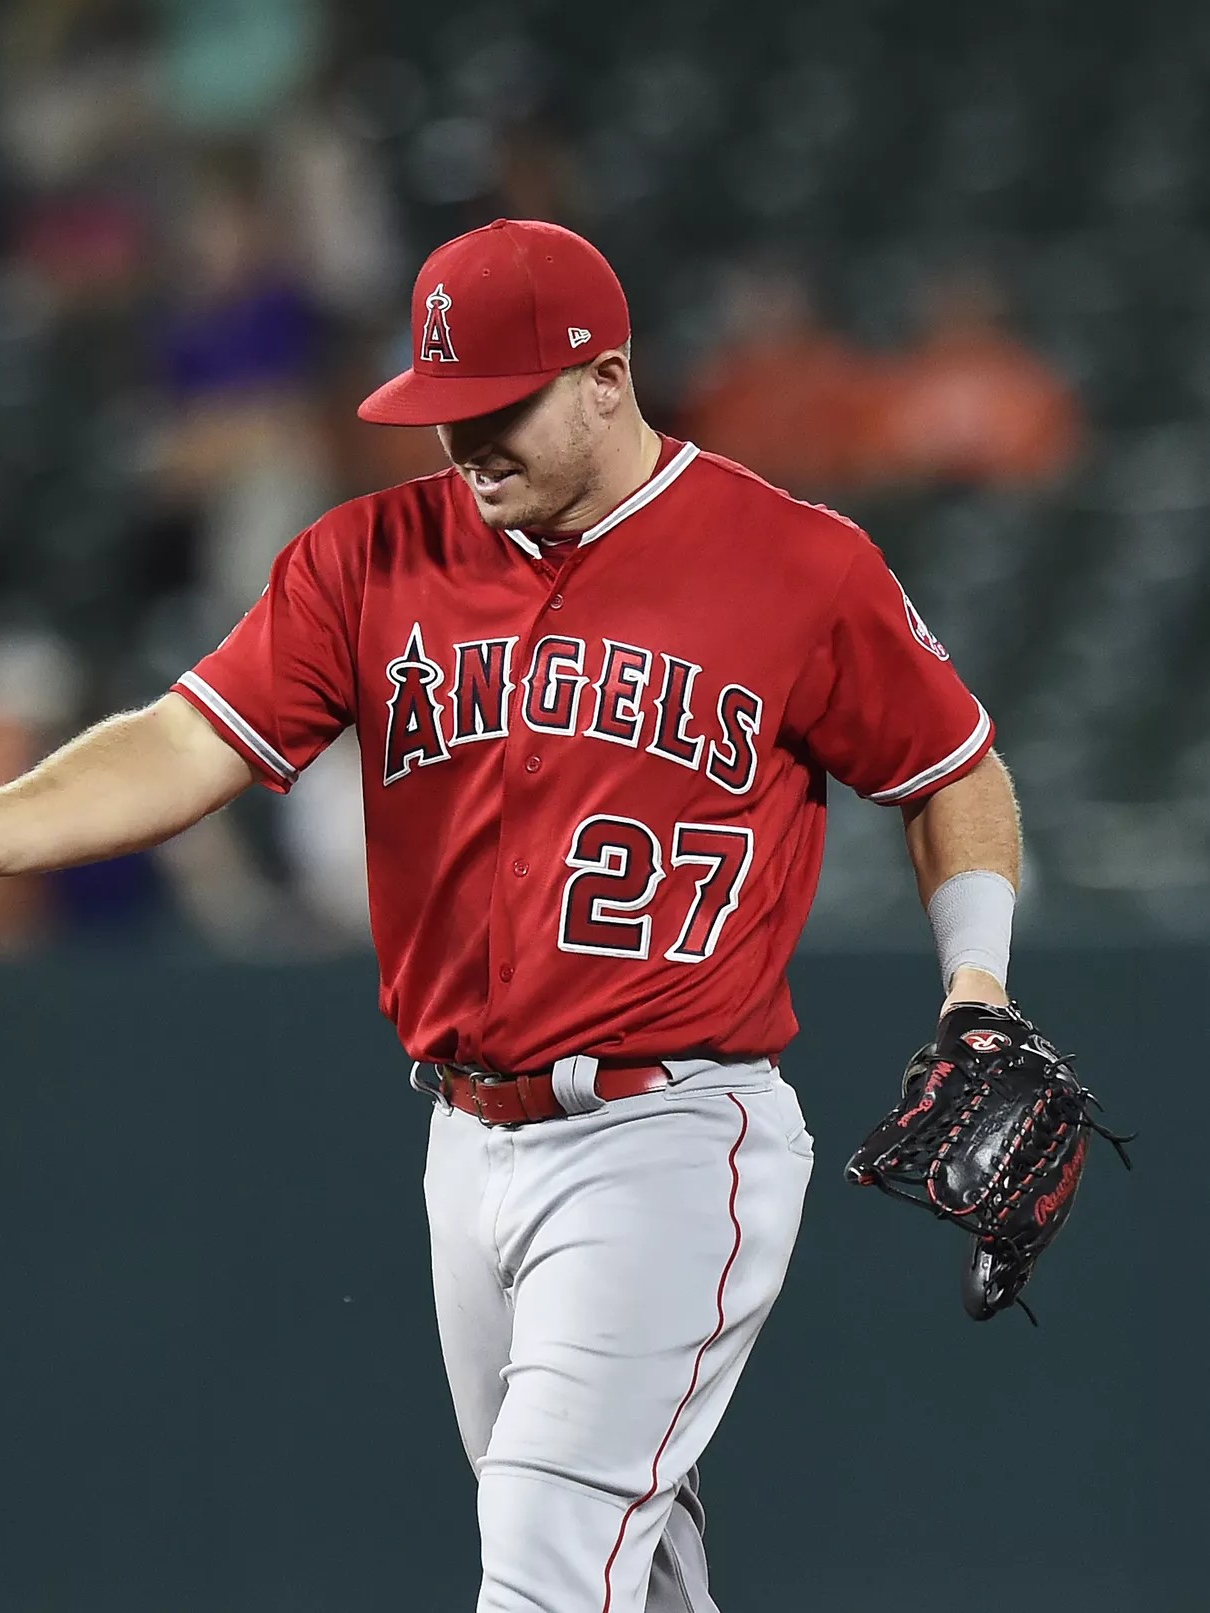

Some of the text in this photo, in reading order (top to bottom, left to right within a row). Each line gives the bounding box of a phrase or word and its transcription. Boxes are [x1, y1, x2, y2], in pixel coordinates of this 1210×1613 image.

[420, 282, 459, 362] A
[383, 621, 763, 795] ANGELS
[557, 813, 754, 964] 27
